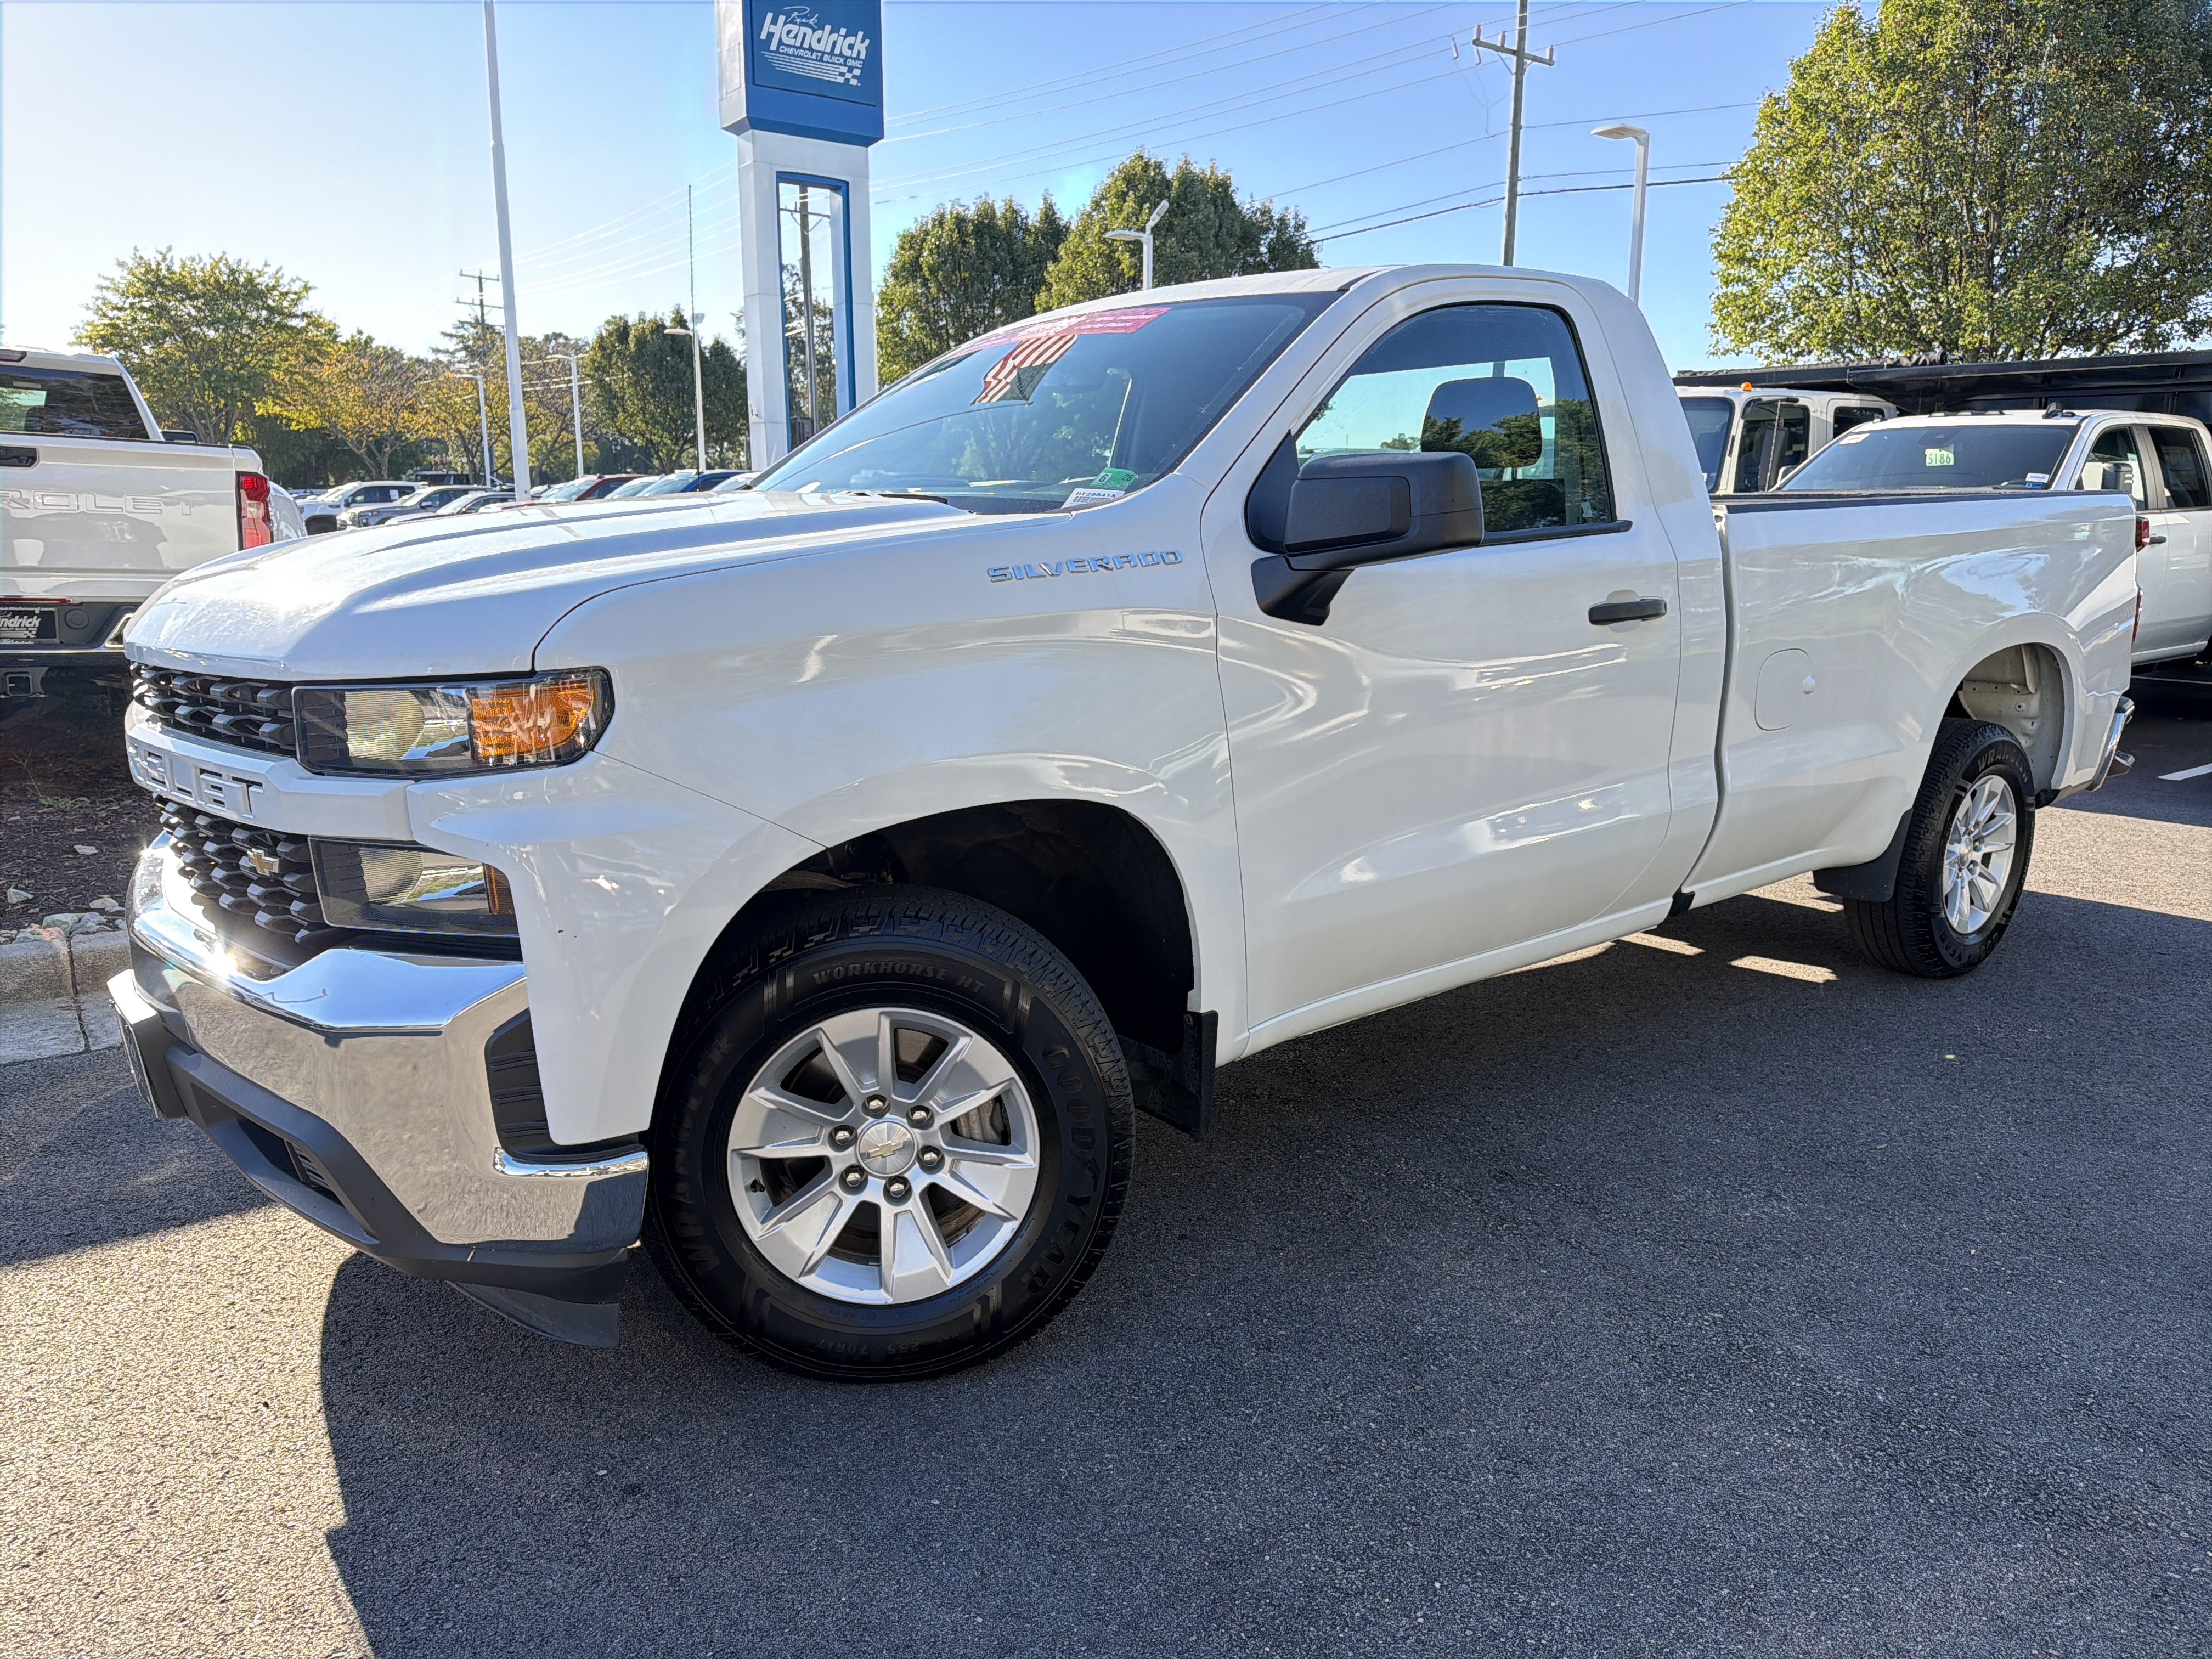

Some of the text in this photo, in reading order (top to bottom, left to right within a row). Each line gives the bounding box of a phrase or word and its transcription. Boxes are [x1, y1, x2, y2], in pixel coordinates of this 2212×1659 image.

[760, 12, 870, 60] Hendrick
[779, 46, 864, 68] CHEVROLET BUICK GMC
[1928, 453, 1951, 465] 5186
[1121, 473, 1135, 482] 26
[987, 550, 1183, 583] SILVERADO
[0, 615, 42, 627] ndrick
[812, 961, 986, 993] WORKHORSE HT
[668, 1030, 734, 1276] WRANGLER
[1022, 1044, 1097, 1295] GOODYEAR
